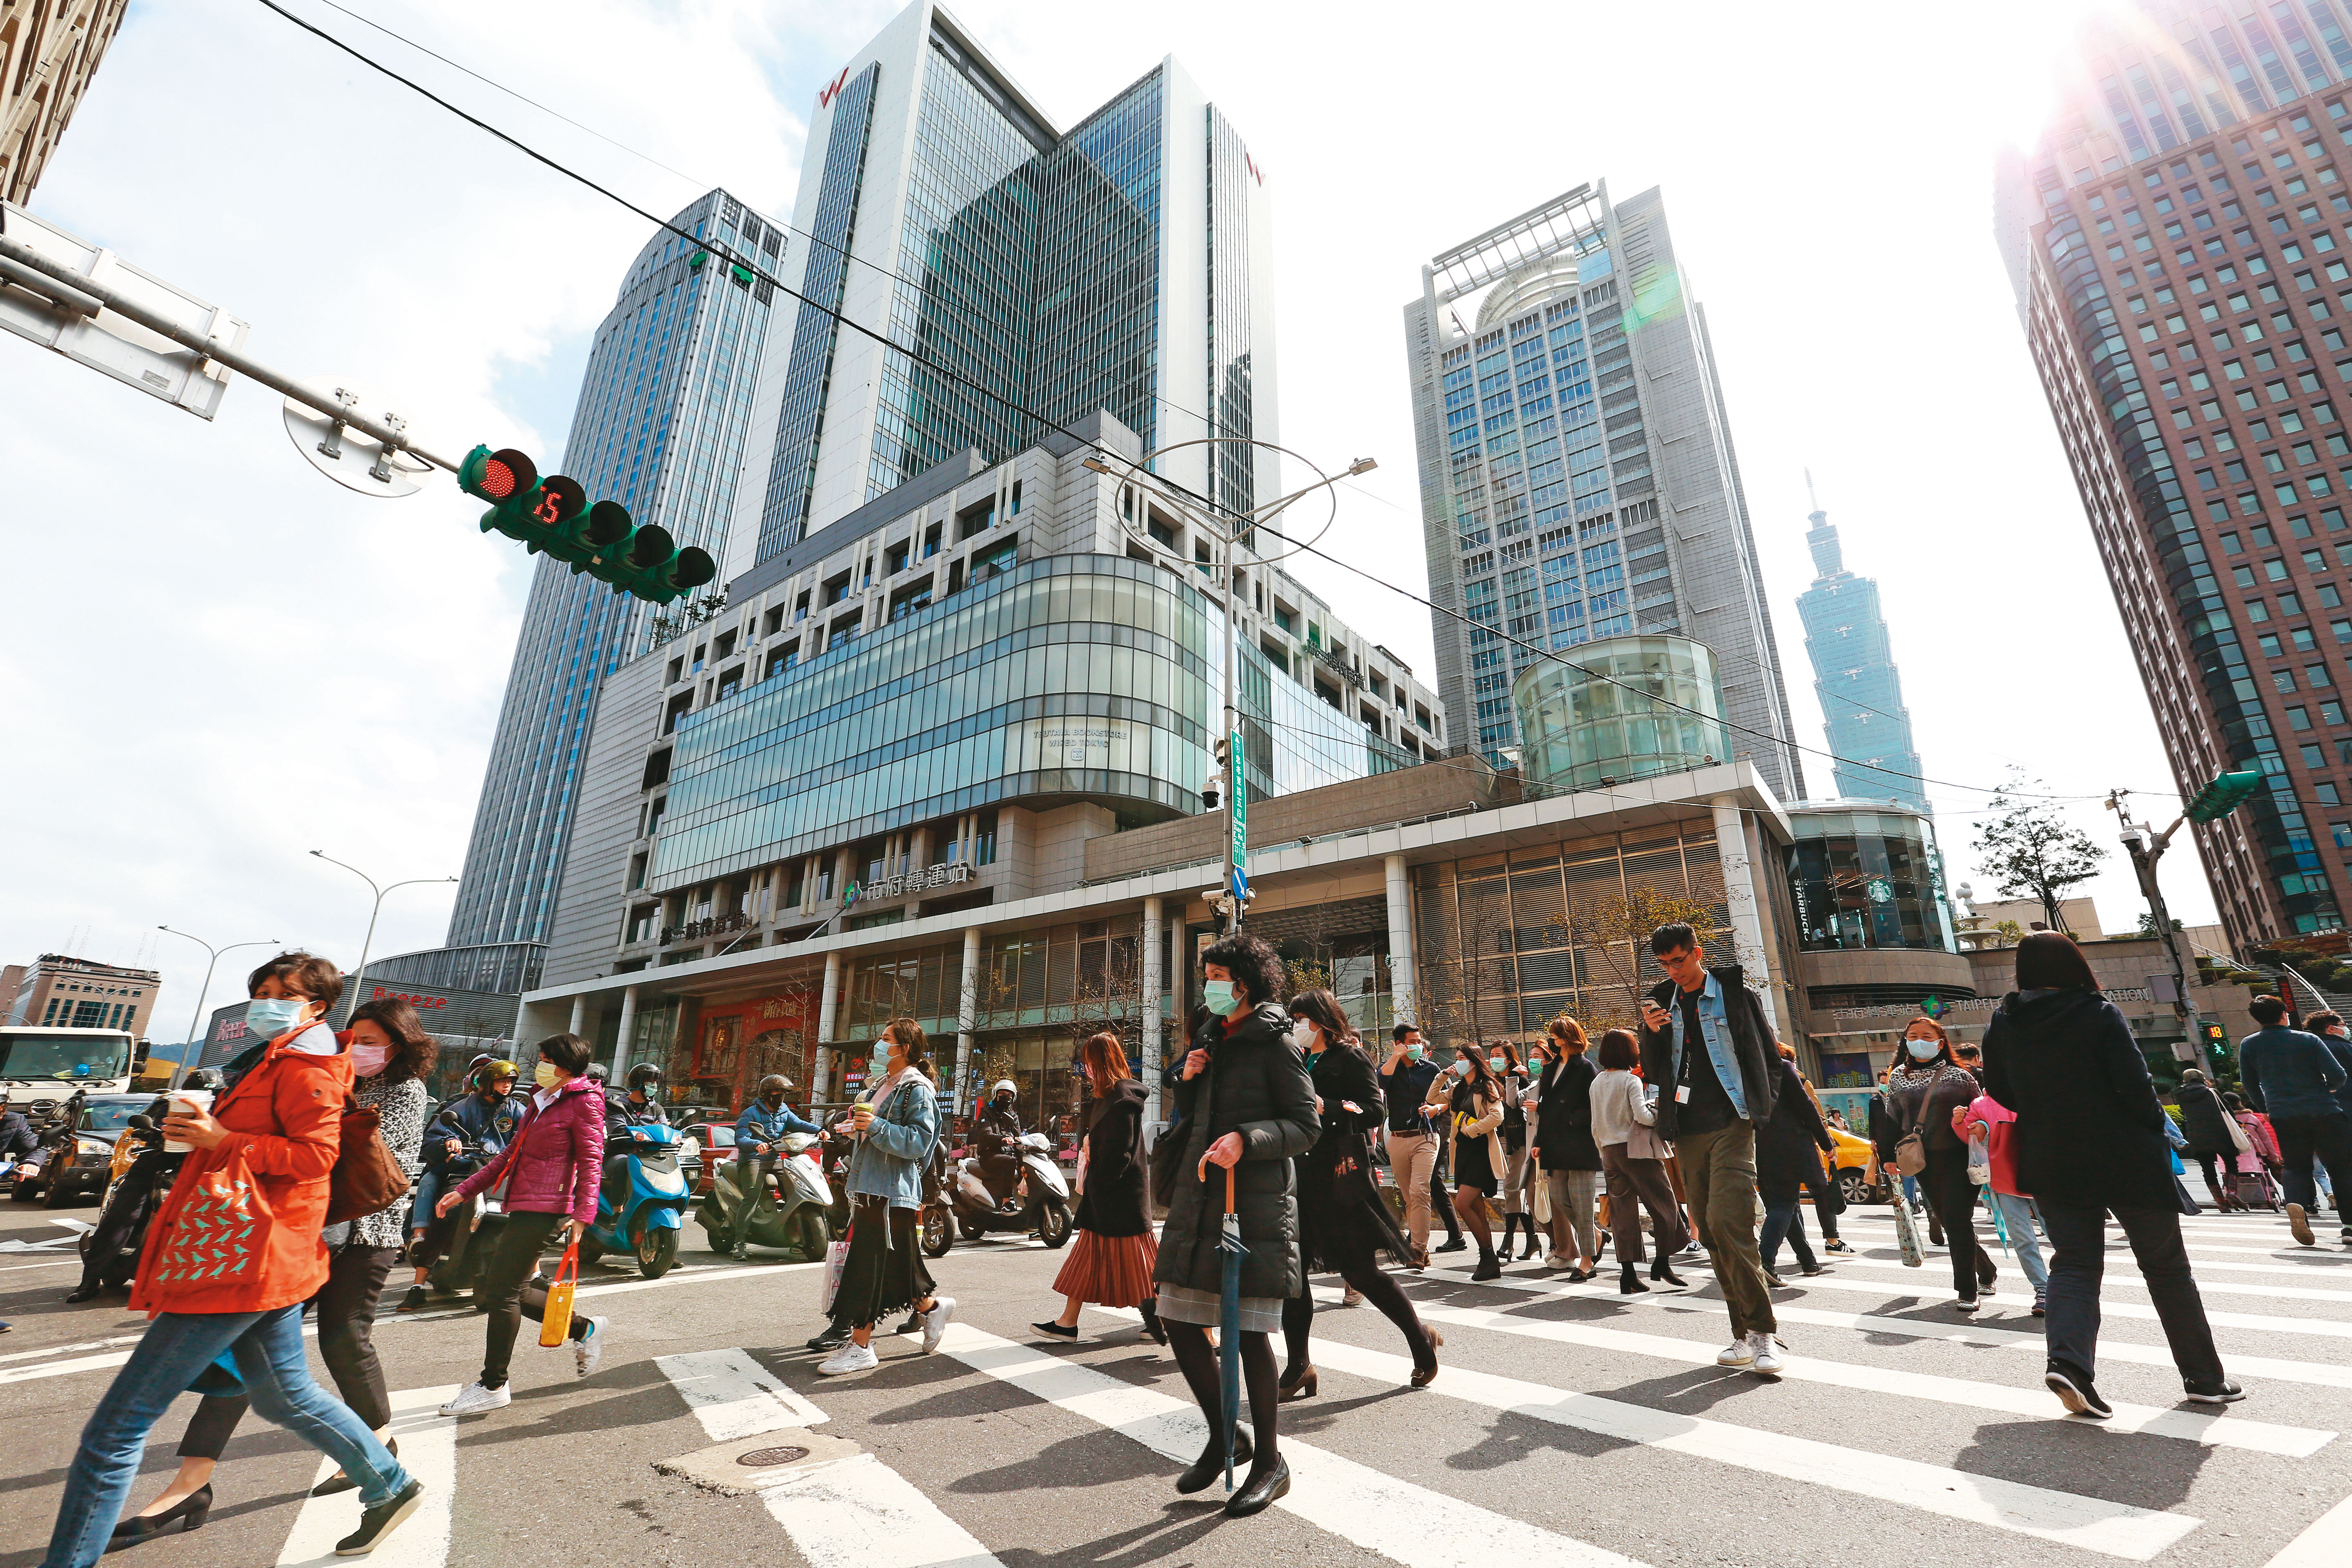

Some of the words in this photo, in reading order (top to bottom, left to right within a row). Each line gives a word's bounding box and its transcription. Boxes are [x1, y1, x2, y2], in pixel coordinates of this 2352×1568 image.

[1033, 729, 1070, 738] TSUTAYA
[1073, 729, 1127, 739] BOOKSTORE
[1234, 817, 1245, 830] Zhong
[1234, 824, 1242, 833] Xiao
[867, 859, 968, 901] 市府轉運站
[659, 910, 745, 946] 統一時代百貨
[1955, 998, 1993, 1011] TAIPEI
[1835, 1004, 1913, 1019] 市府轉運站
[715, 1029, 725, 1047] 春
[2209, 1026, 2223, 1038] 18
[1828, 1074, 1870, 1088] 刮刮樂
